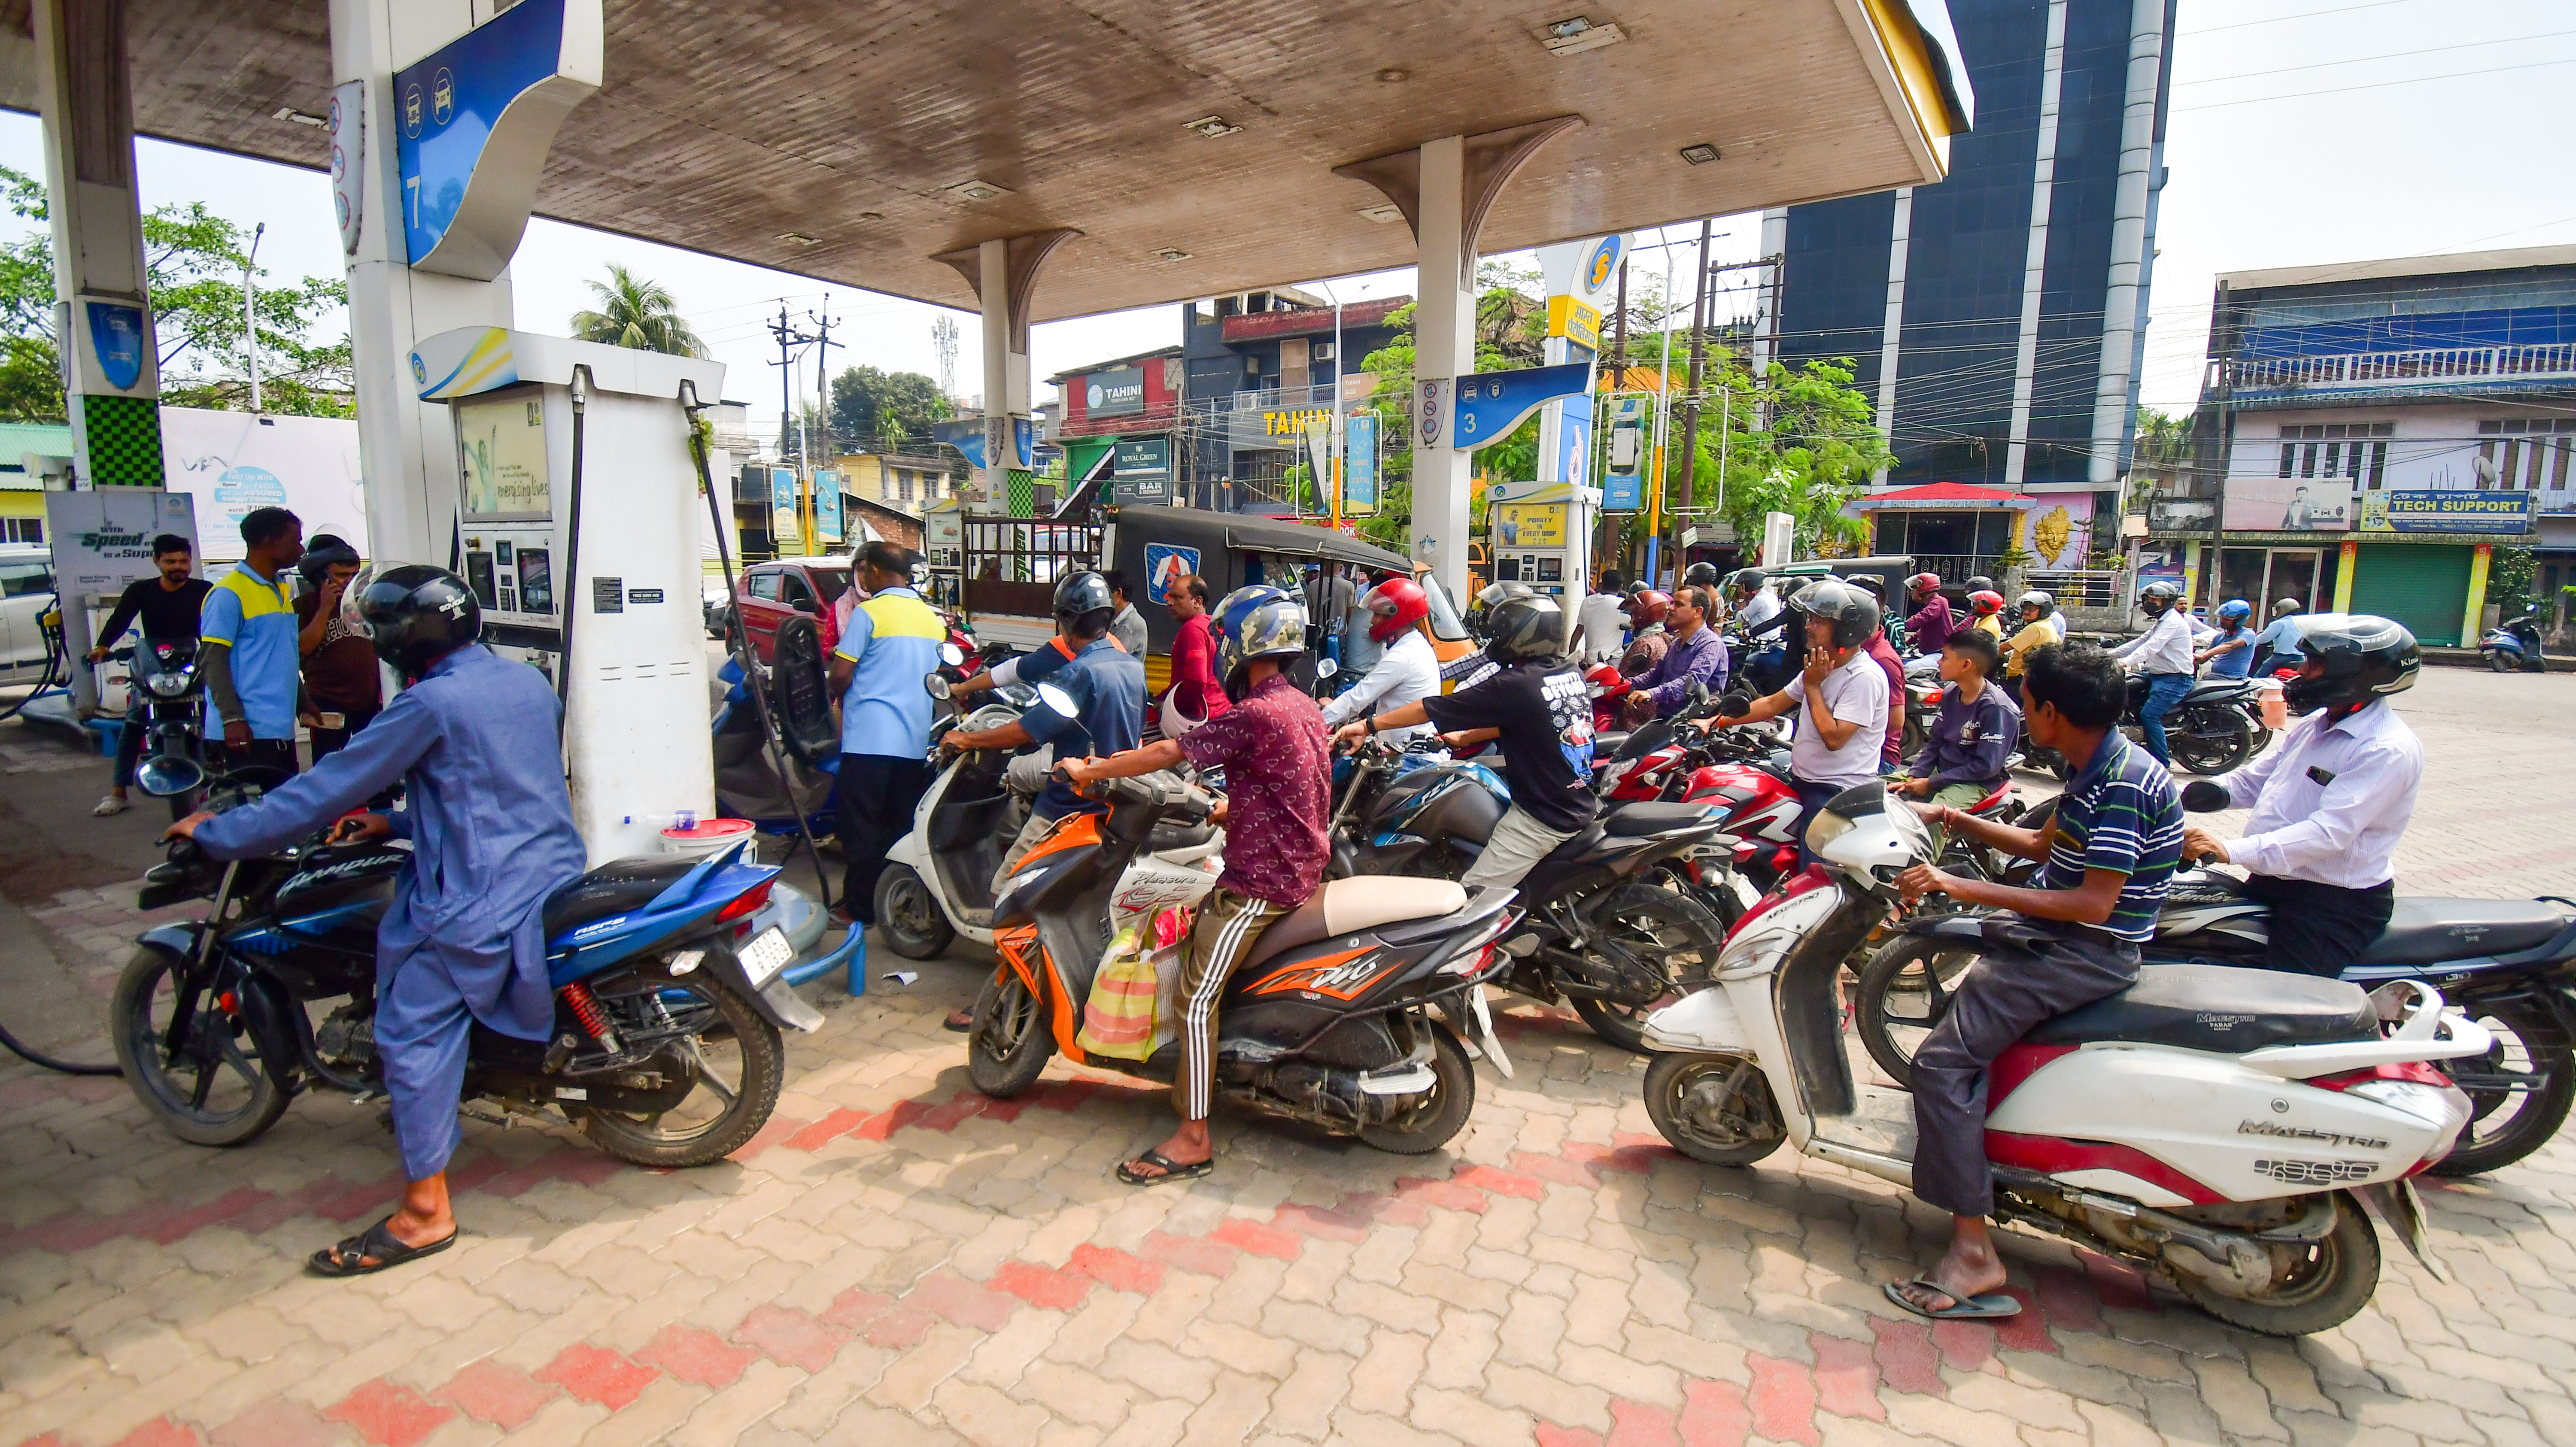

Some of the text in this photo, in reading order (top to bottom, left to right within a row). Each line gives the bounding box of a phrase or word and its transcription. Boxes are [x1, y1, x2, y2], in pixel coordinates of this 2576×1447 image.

[406, 176, 419, 229] 7
[1576, 305, 1593, 325] भारत
[1106, 385, 1141, 398] TAHINI
[1464, 413, 1476, 434] 3
[2393, 501, 2521, 512] TECH SUPPORT
[82, 532, 145, 552] Speed
[1541, 680, 1587, 701] BEYOND
[1132, 872, 1197, 886] Pleasure
[1767, 892, 1820, 922] MAESTRO
[752, 941, 765, 959] AS
[758, 943, 789, 975] R 2829
[2196, 1013, 2256, 1025] MAESTRO
[2237, 1119, 2392, 1149] MAESTRO
